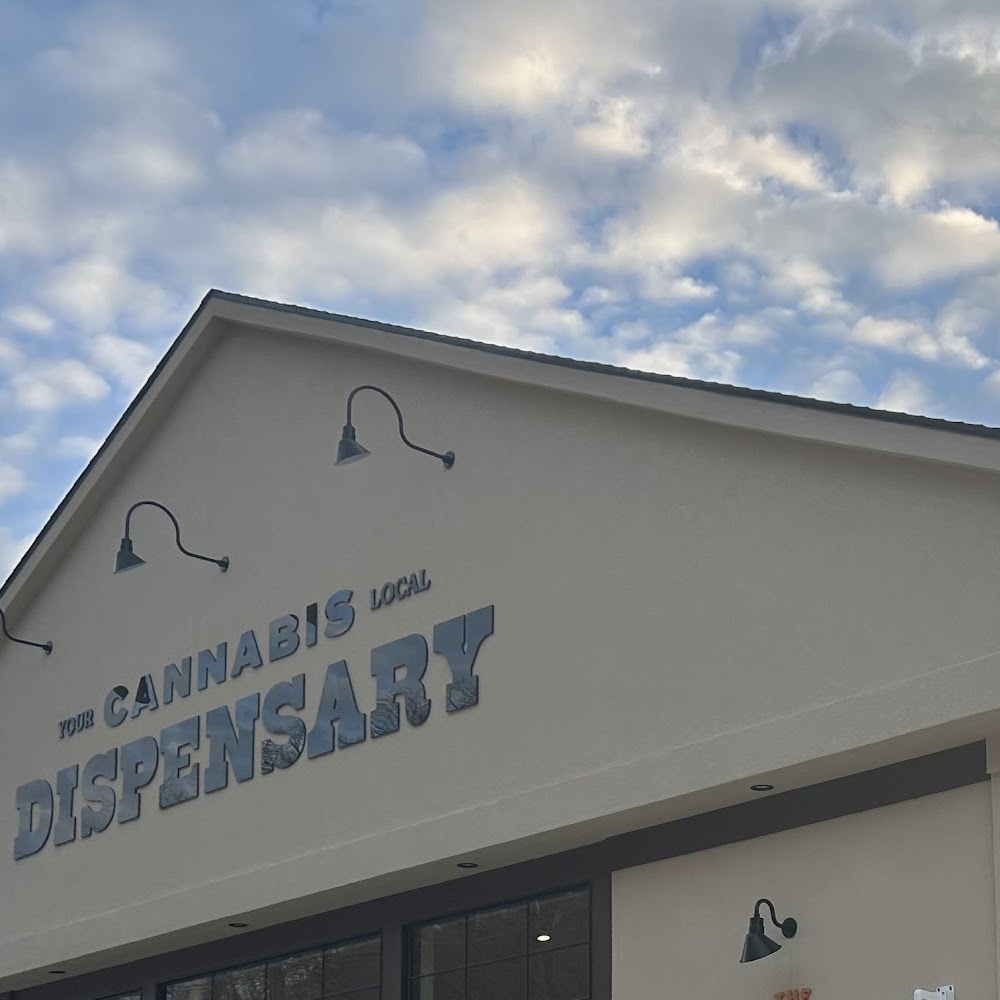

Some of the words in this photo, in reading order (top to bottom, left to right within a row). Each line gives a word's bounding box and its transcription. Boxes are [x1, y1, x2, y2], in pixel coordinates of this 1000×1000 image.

[14, 604, 494, 860] DISPENSARY
[58, 709, 95, 738] YOUR
[103, 589, 355, 727] CANNABIS
[370, 569, 431, 610] LOCAL
